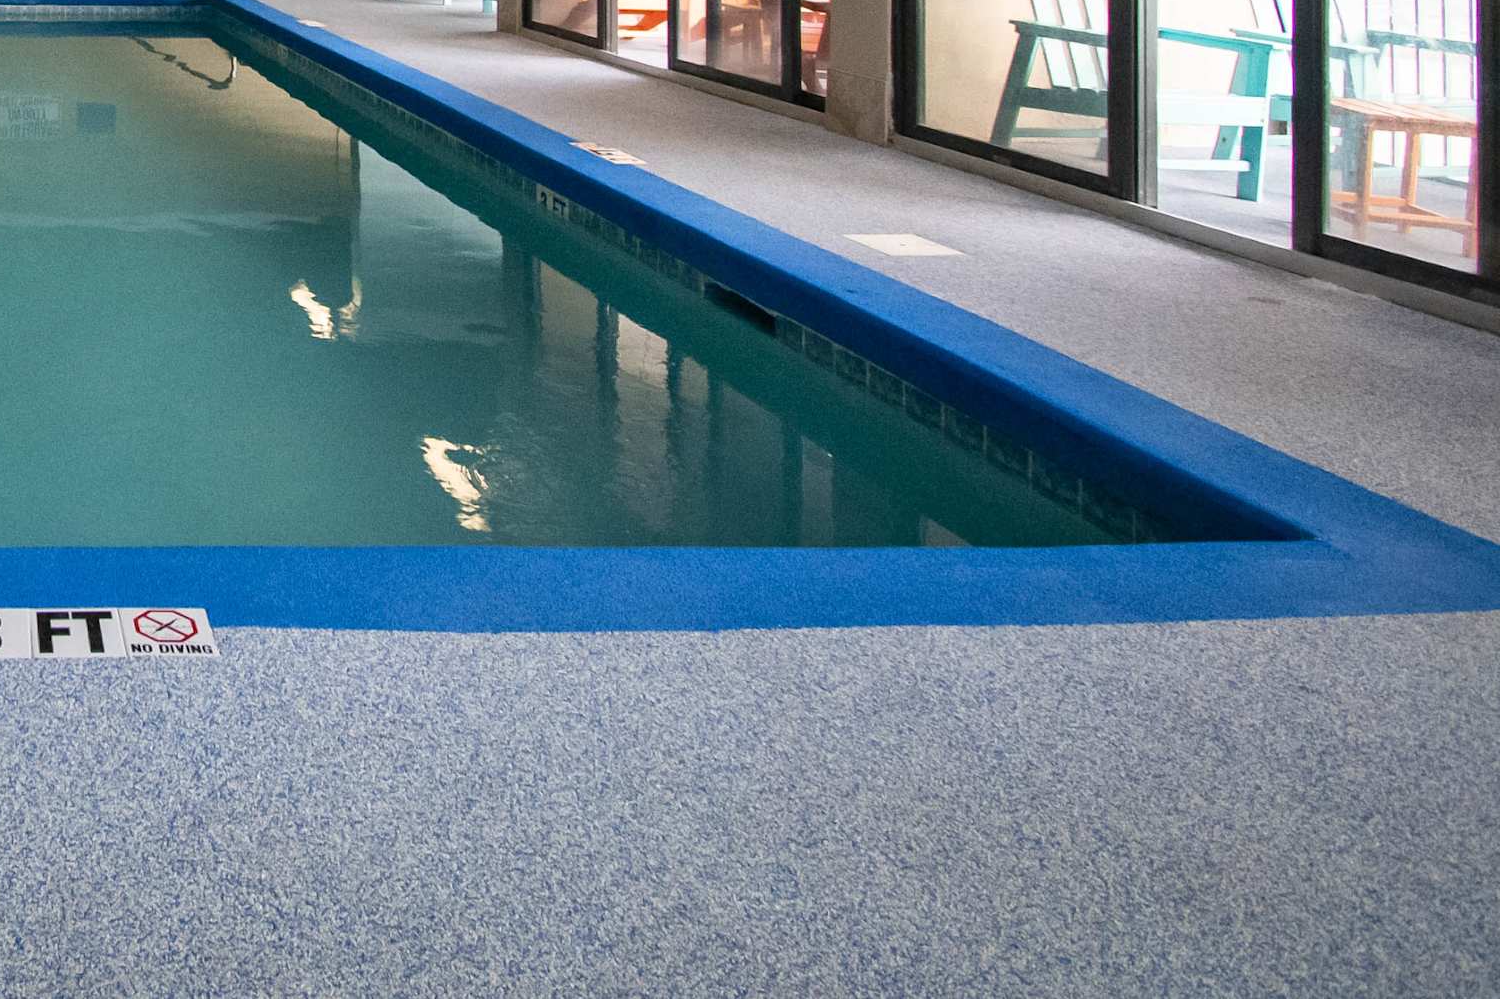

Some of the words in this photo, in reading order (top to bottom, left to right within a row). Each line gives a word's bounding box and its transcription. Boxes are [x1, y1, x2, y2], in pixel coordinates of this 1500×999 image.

[36, 611, 112, 654] FT
[131, 643, 152, 653] NO
[159, 643, 213, 654] DIVING
